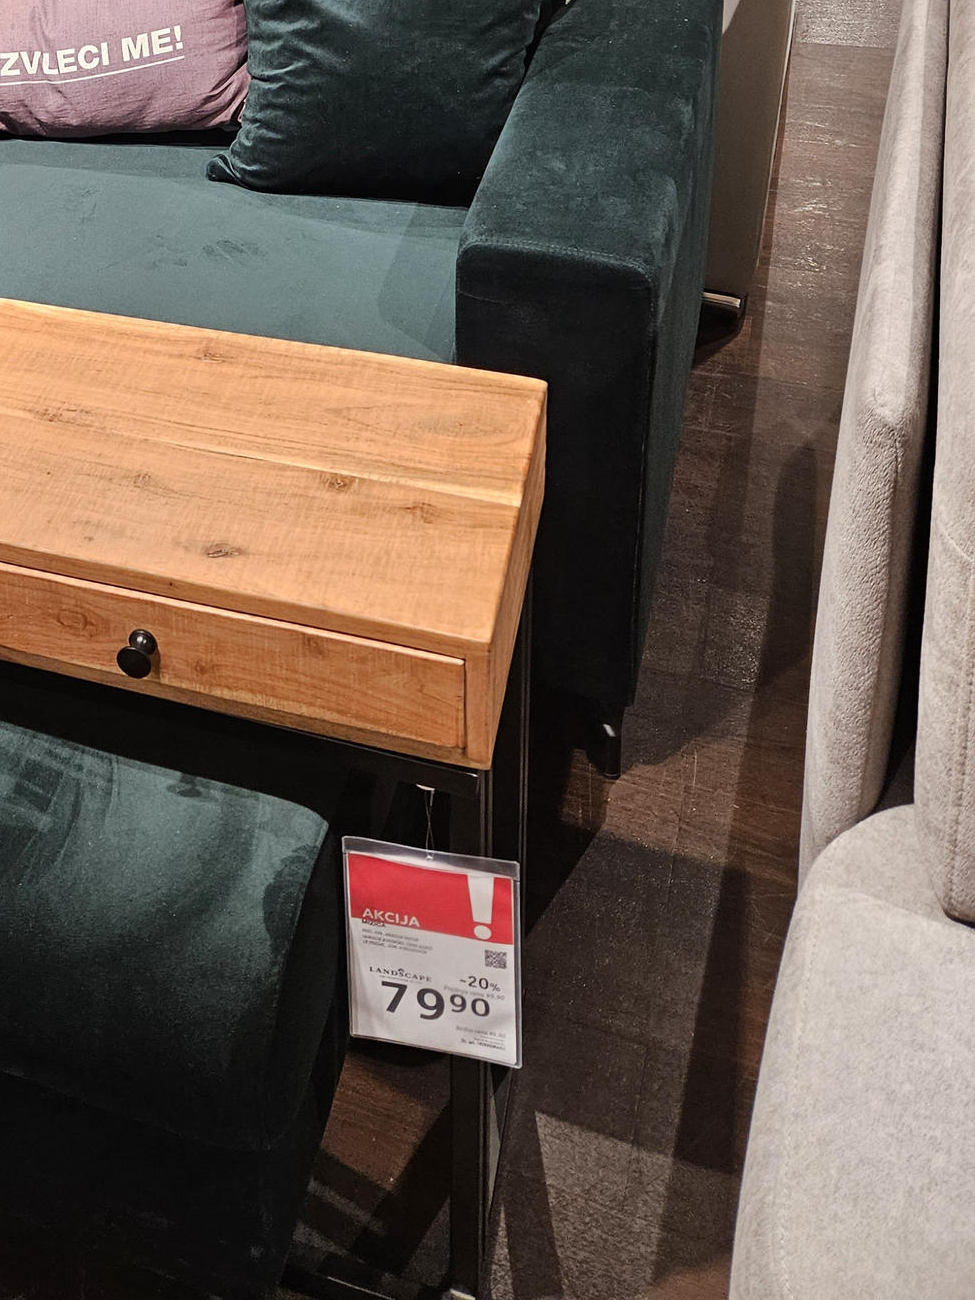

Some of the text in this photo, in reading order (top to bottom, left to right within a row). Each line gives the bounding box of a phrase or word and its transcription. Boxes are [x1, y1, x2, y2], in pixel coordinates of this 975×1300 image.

[121, 25, 184, 63] ME!
[362, 908, 420, 928] AKCIJA
[460, 975, 501, 992] -20%
